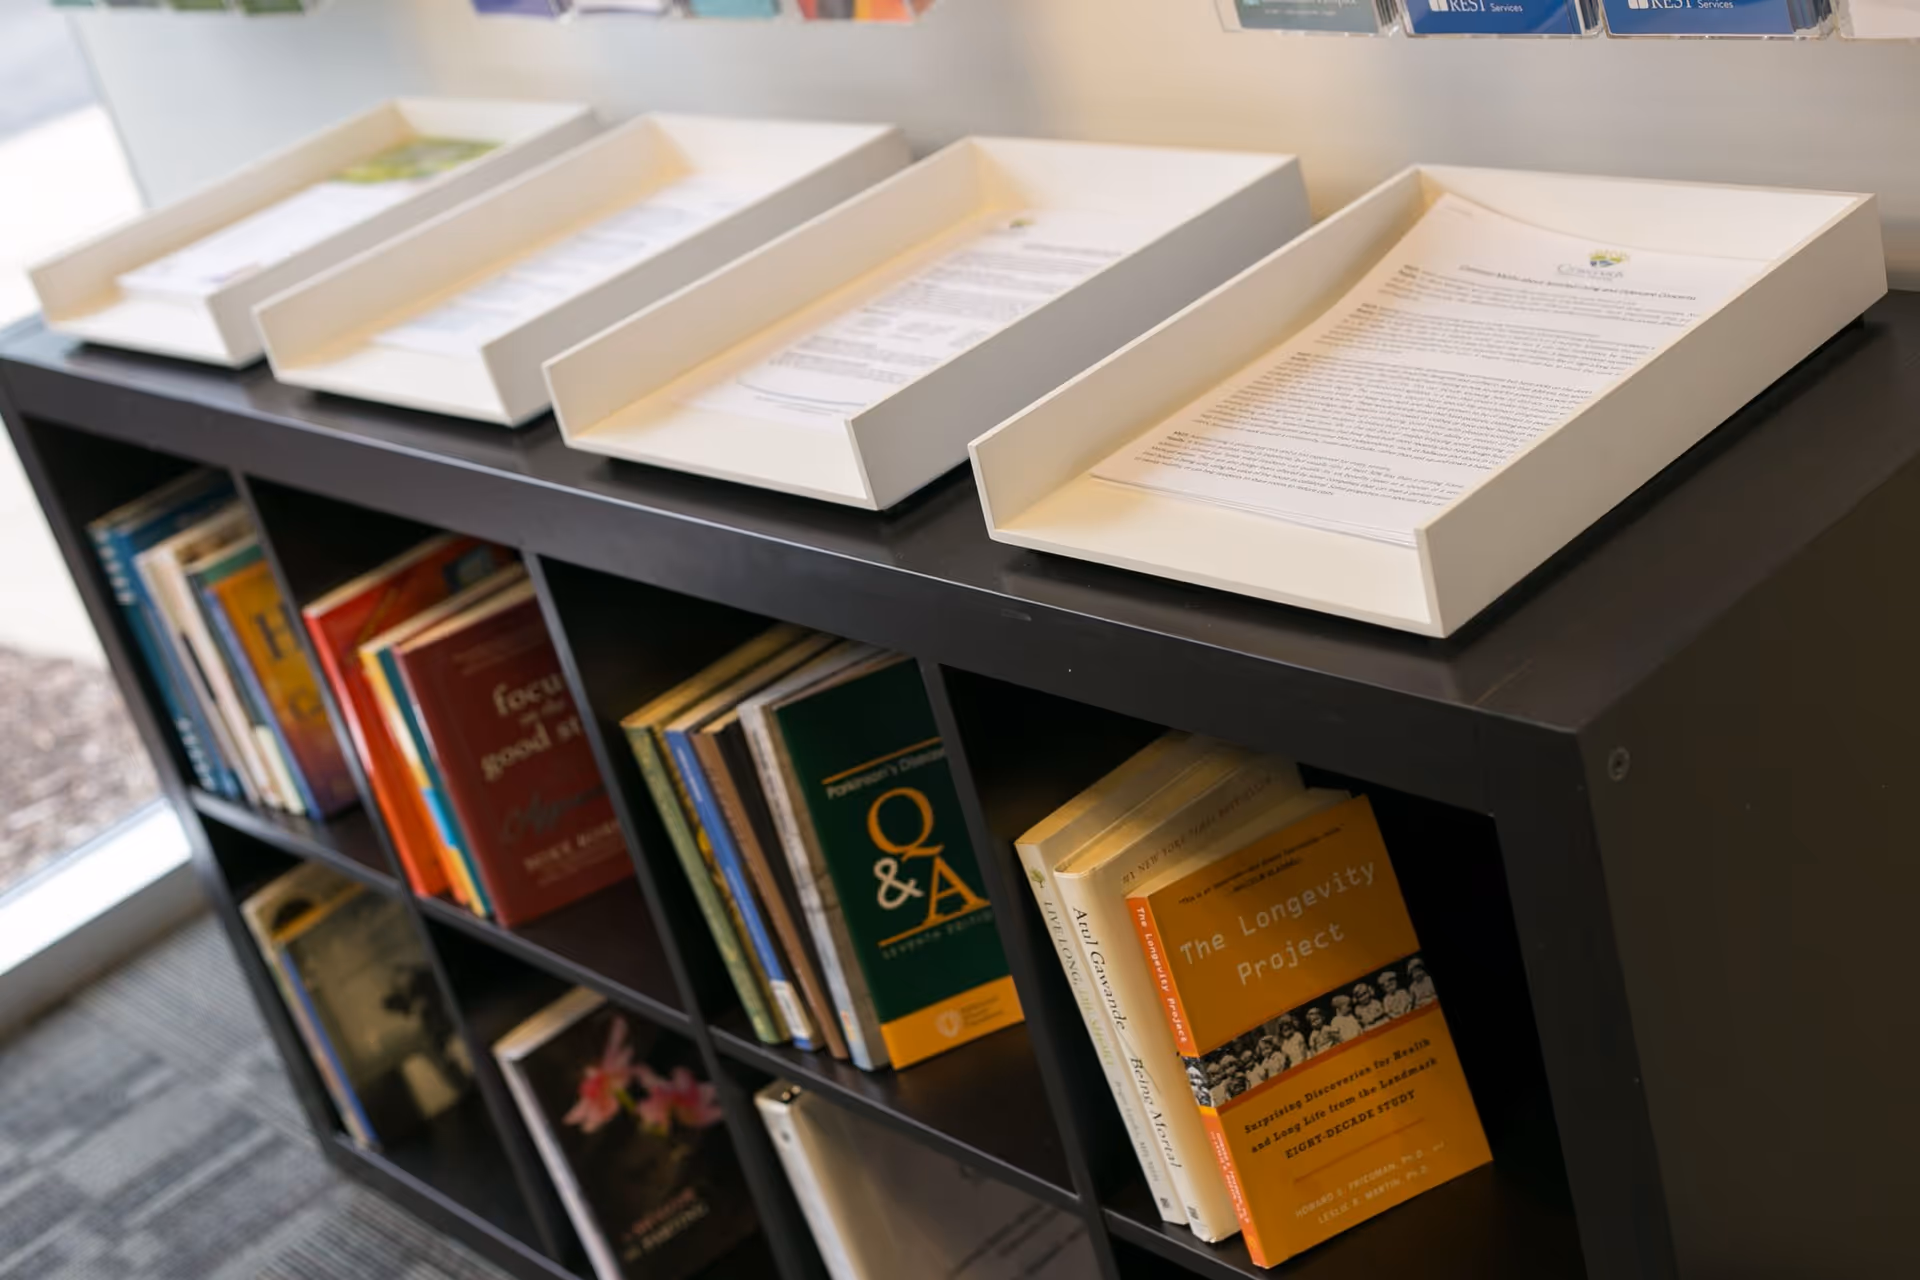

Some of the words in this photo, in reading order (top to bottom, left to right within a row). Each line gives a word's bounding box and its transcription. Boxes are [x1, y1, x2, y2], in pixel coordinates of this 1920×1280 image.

[1137, 851, 1160, 872] NEW
[1179, 931, 1226, 965] The
[1238, 862, 1375, 937] Longevity
[1236, 922, 1345, 987] Project
[1073, 906, 1099, 947] Atul
[1090, 950, 1128, 1030] Gawande
[1136, 906, 1149, 928] The
[1144, 933, 1171, 993] Longevity
[1166, 997, 1189, 1044] Project
[1130, 1056, 1154, 1106] Being
[1150, 1111, 1183, 1169] Mortal
[1244, 1099, 1303, 1134] Surprising
[1304, 1066, 1372, 1104] Discoveries
[1373, 1057, 1391, 1070] for
[1393, 1038, 1431, 1062] Health
[1251, 1134, 1272, 1154] and
[1273, 1121, 1302, 1142] Long
[1303, 1109, 1327, 1127] Life
[1328, 1096, 1356, 1115] from
[1358, 1085, 1378, 1100] the
[1379, 1057, 1438, 1090] Landmark
[1284, 1107, 1376, 1160] EIGHT-DECADE
[1376, 1088, 1416, 1116] STUDY
